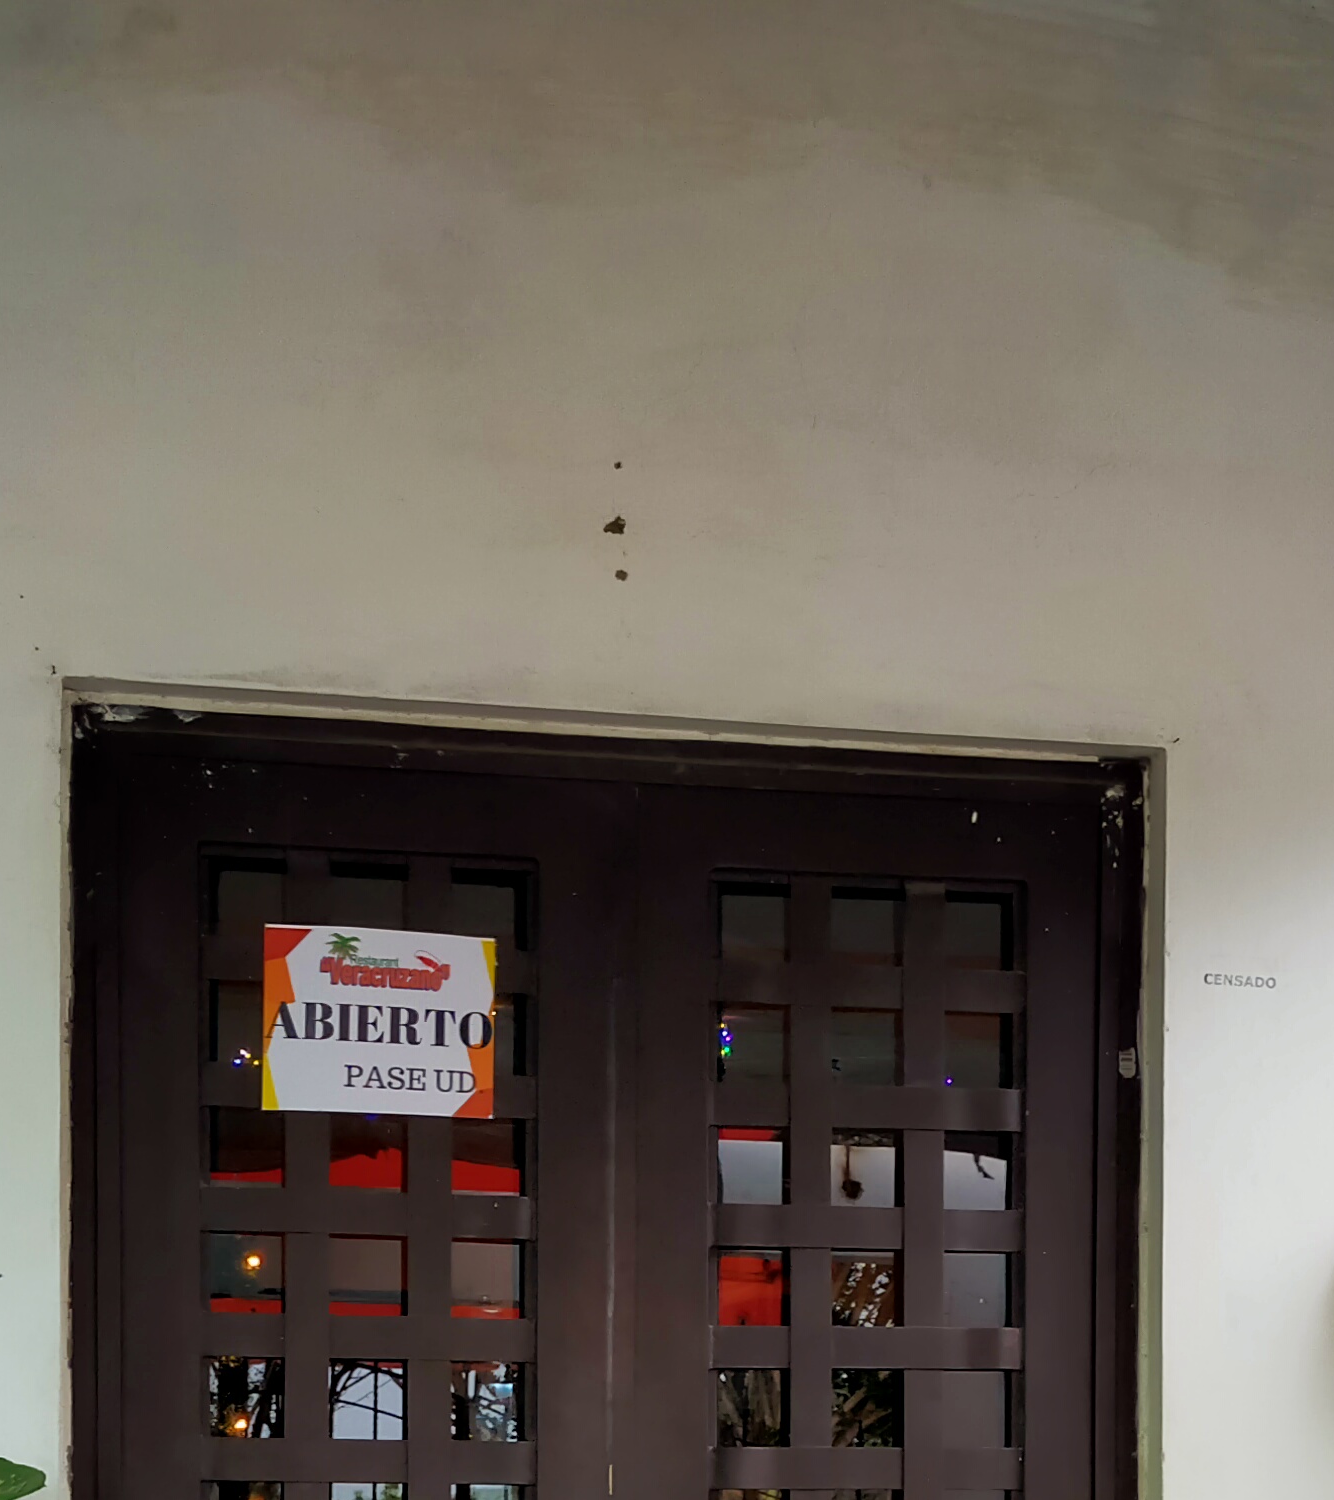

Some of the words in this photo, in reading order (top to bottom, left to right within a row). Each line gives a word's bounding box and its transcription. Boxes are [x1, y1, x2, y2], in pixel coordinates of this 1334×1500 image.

[349, 954, 399, 968] Restaurant
[1203, 973, 1277, 989] CENSADO
[266, 1001, 493, 1049] ABIERTO
[343, 1064, 427, 1091] PASE
[434, 1069, 478, 1093] UD
